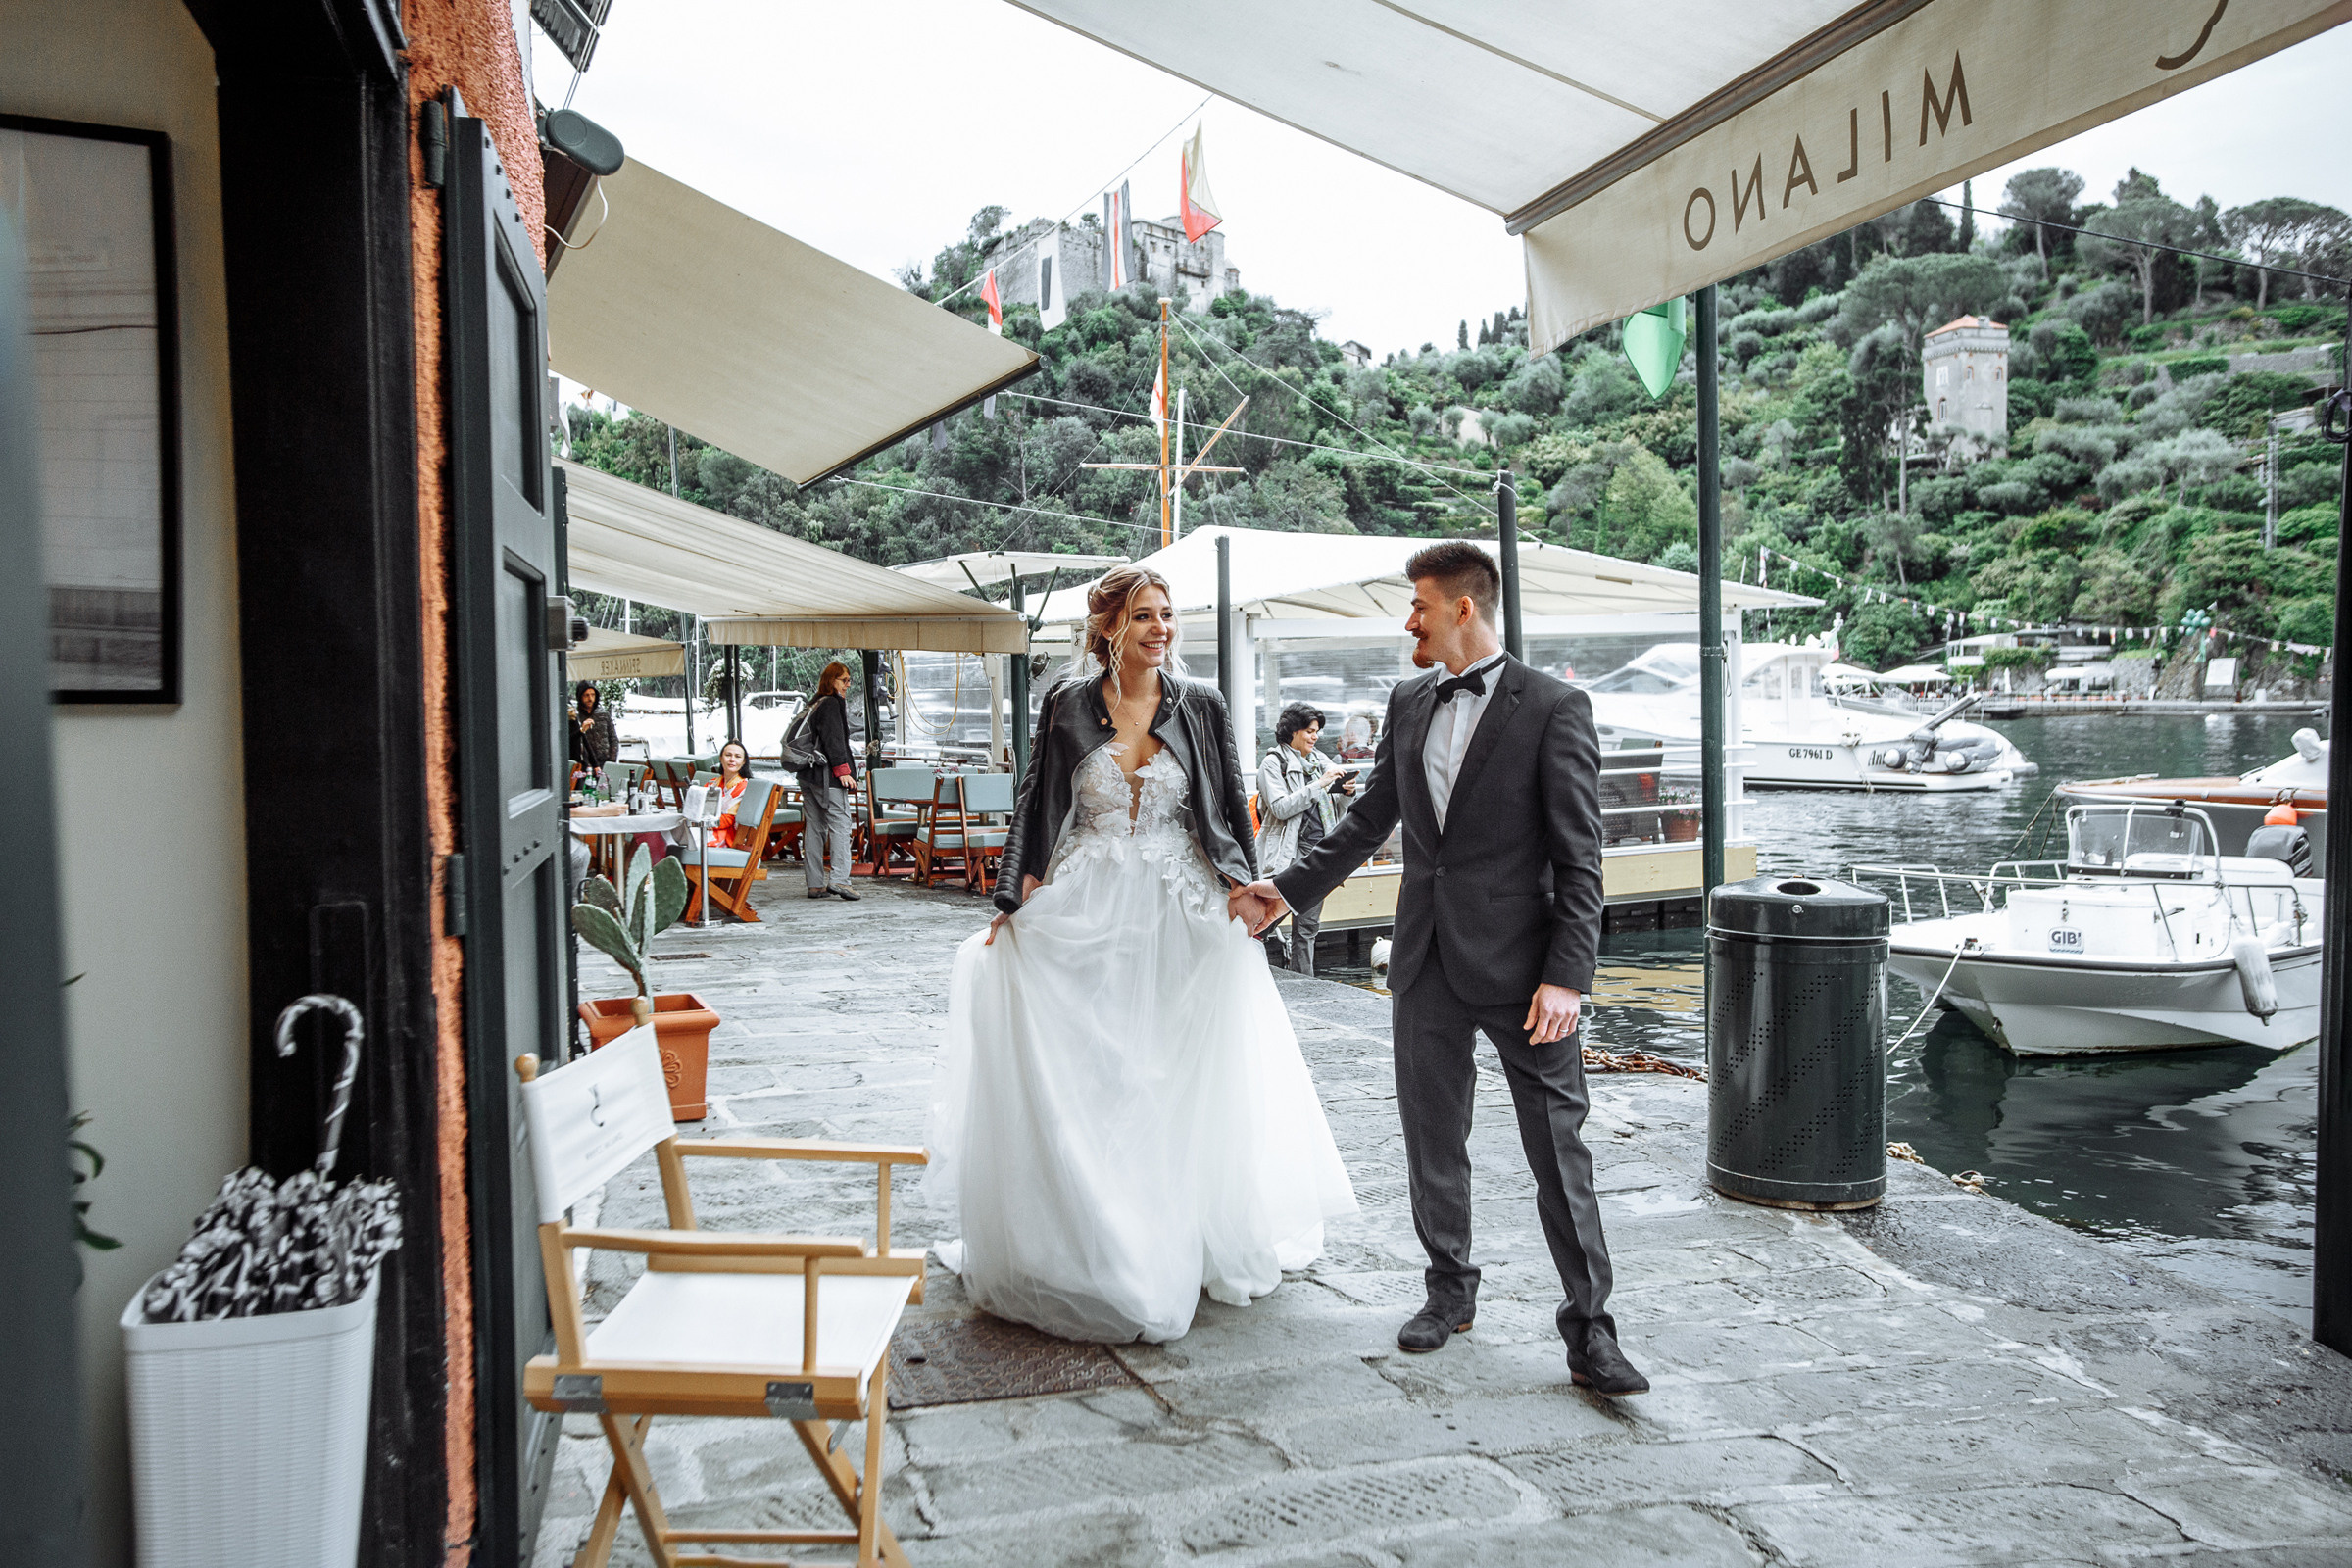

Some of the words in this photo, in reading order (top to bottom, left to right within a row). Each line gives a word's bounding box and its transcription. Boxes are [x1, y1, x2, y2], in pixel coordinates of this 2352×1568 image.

[1789, 748, 1802, 759] GE
[1803, 749, 1824, 760] 7961
[1826, 750, 1833, 760] D
